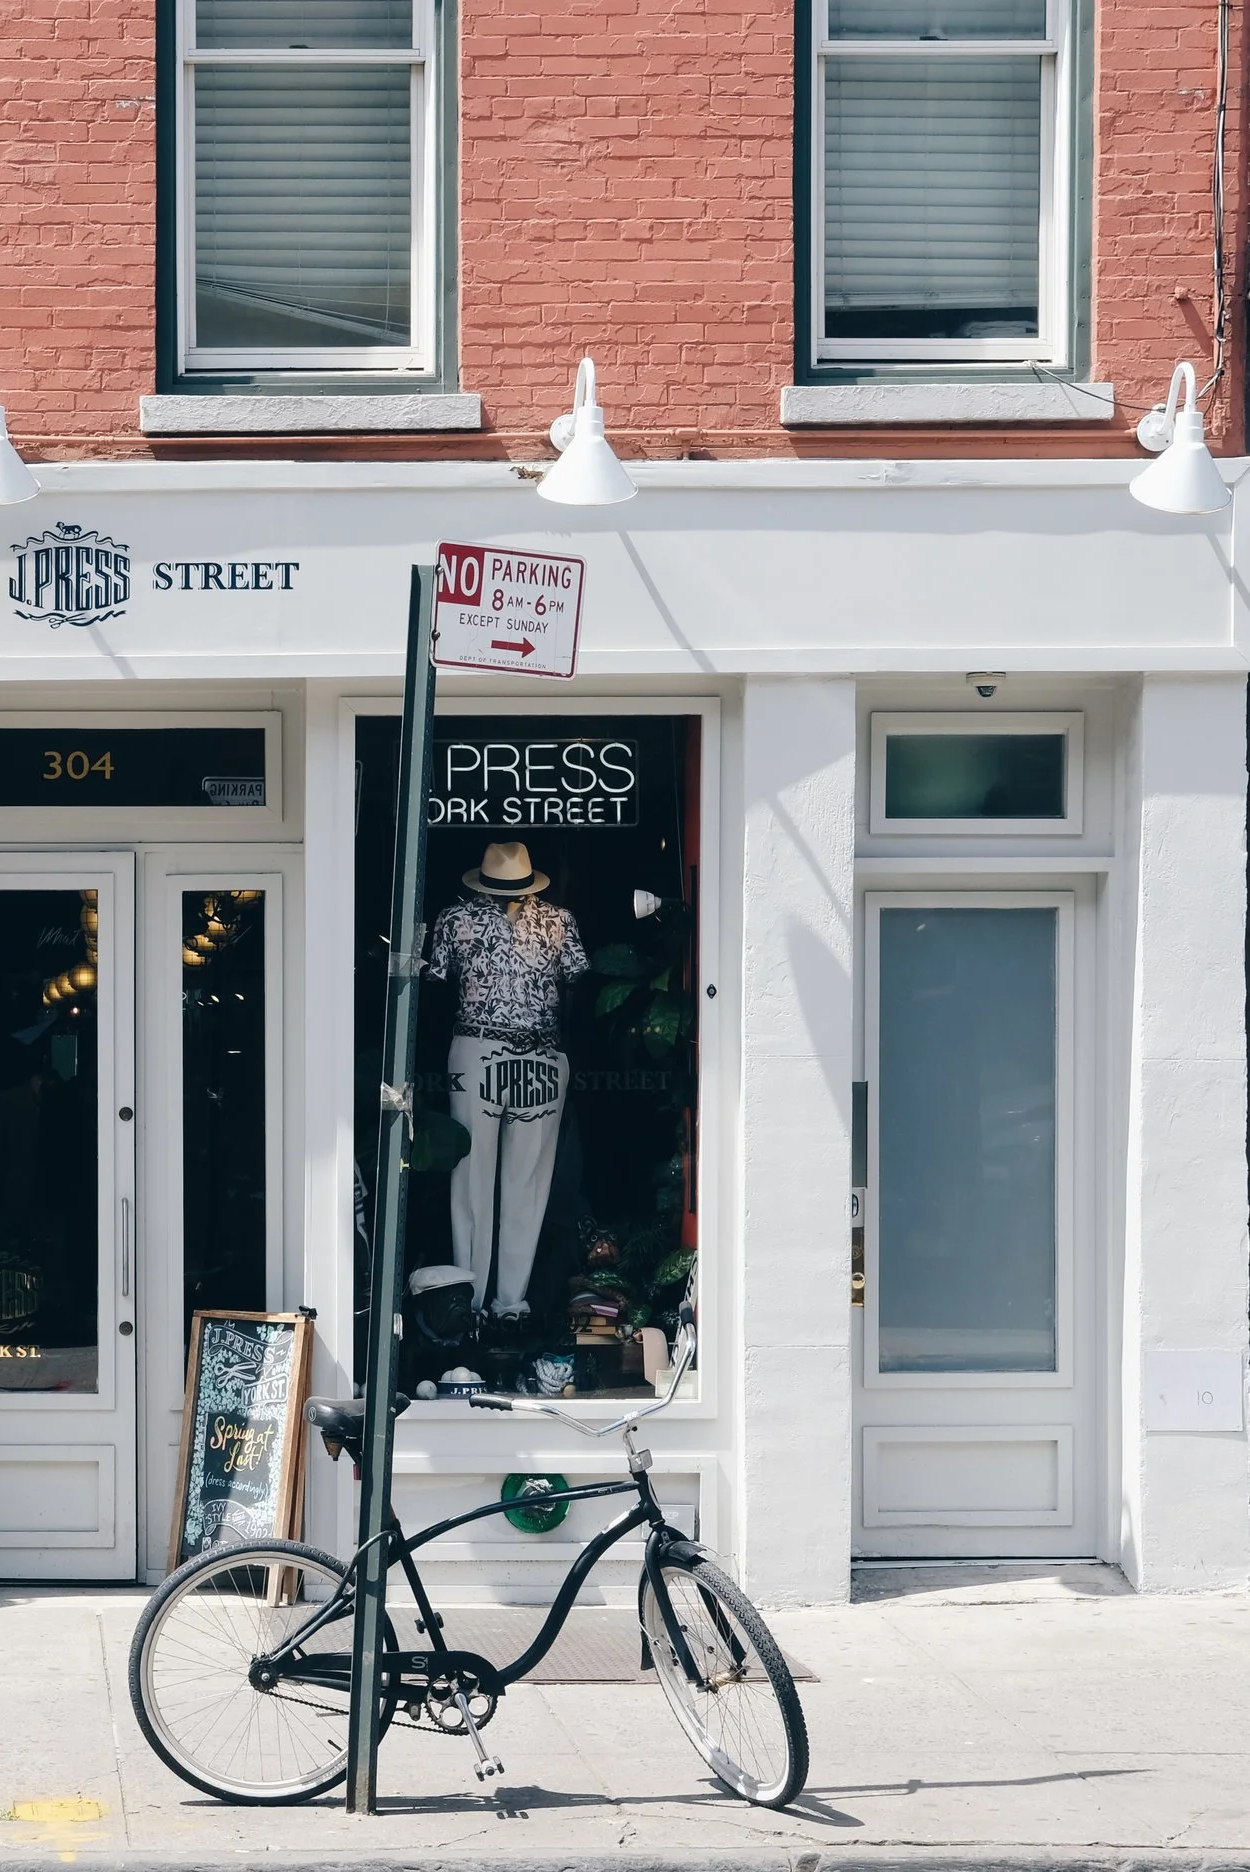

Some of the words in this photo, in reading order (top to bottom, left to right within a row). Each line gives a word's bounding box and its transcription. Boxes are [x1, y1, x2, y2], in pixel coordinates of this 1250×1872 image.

[8, 545, 131, 612] J.PRESS
[152, 561, 300, 591] STREET
[438, 553, 480, 598] NO
[491, 557, 572, 590] PARKING
[459, 612, 501, 629] EXCEPT
[506, 618, 549, 634] SUNDAY
[43, 750, 116, 780] 304
[428, 796, 490, 824] ORK
[501, 796, 629, 825] STREET
[414, 1071, 466, 1092] ORK
[479, 1060, 559, 1108] J.PRESS
[573, 1070, 672, 1092] STREET
[16, 1344, 42, 1358] ST.
[211, 1327, 276, 1364] J.PRESS
[244, 1382, 271, 1405] YORK
[271, 1379, 285, 1399] ST.
[210, 1416, 255, 1453] Spring
[257, 1423, 274, 1452] at
[224, 1441, 264, 1472] Last!
[205, 1471, 226, 1488] (dress
[227, 1480, 269, 1501] accordingly)
[206, 1512, 232, 1525] STYLE
[211, 1502, 227, 1512] IVY
